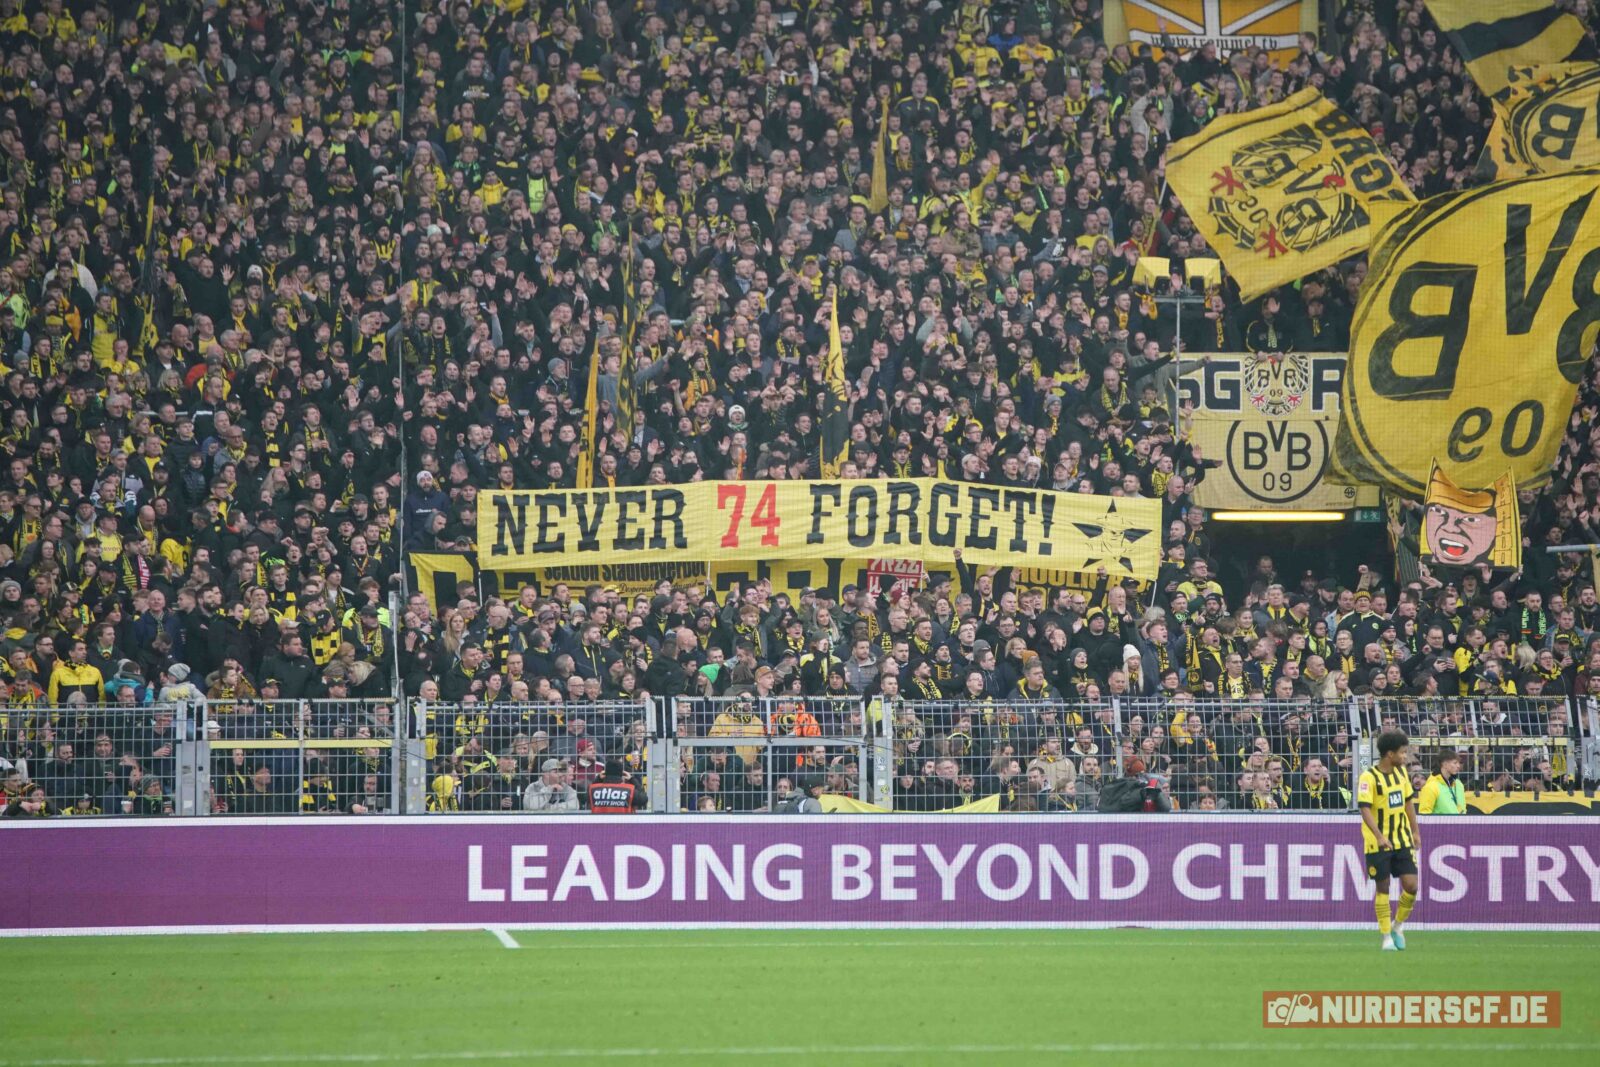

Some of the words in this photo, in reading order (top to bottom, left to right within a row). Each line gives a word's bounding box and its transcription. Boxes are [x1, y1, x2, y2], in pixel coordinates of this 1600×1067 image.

[1257, 361, 1296, 388] BVB
[1242, 420, 1312, 471] BVB
[1262, 471, 1293, 492] 09
[490, 488, 688, 556] NEVER
[716, 483, 781, 548] 74
[806, 481, 1056, 556] FORGET!
[593, 787, 628, 800] atlas
[467, 844, 804, 902] LEADING
[831, 843, 1150, 902] BEYOND
